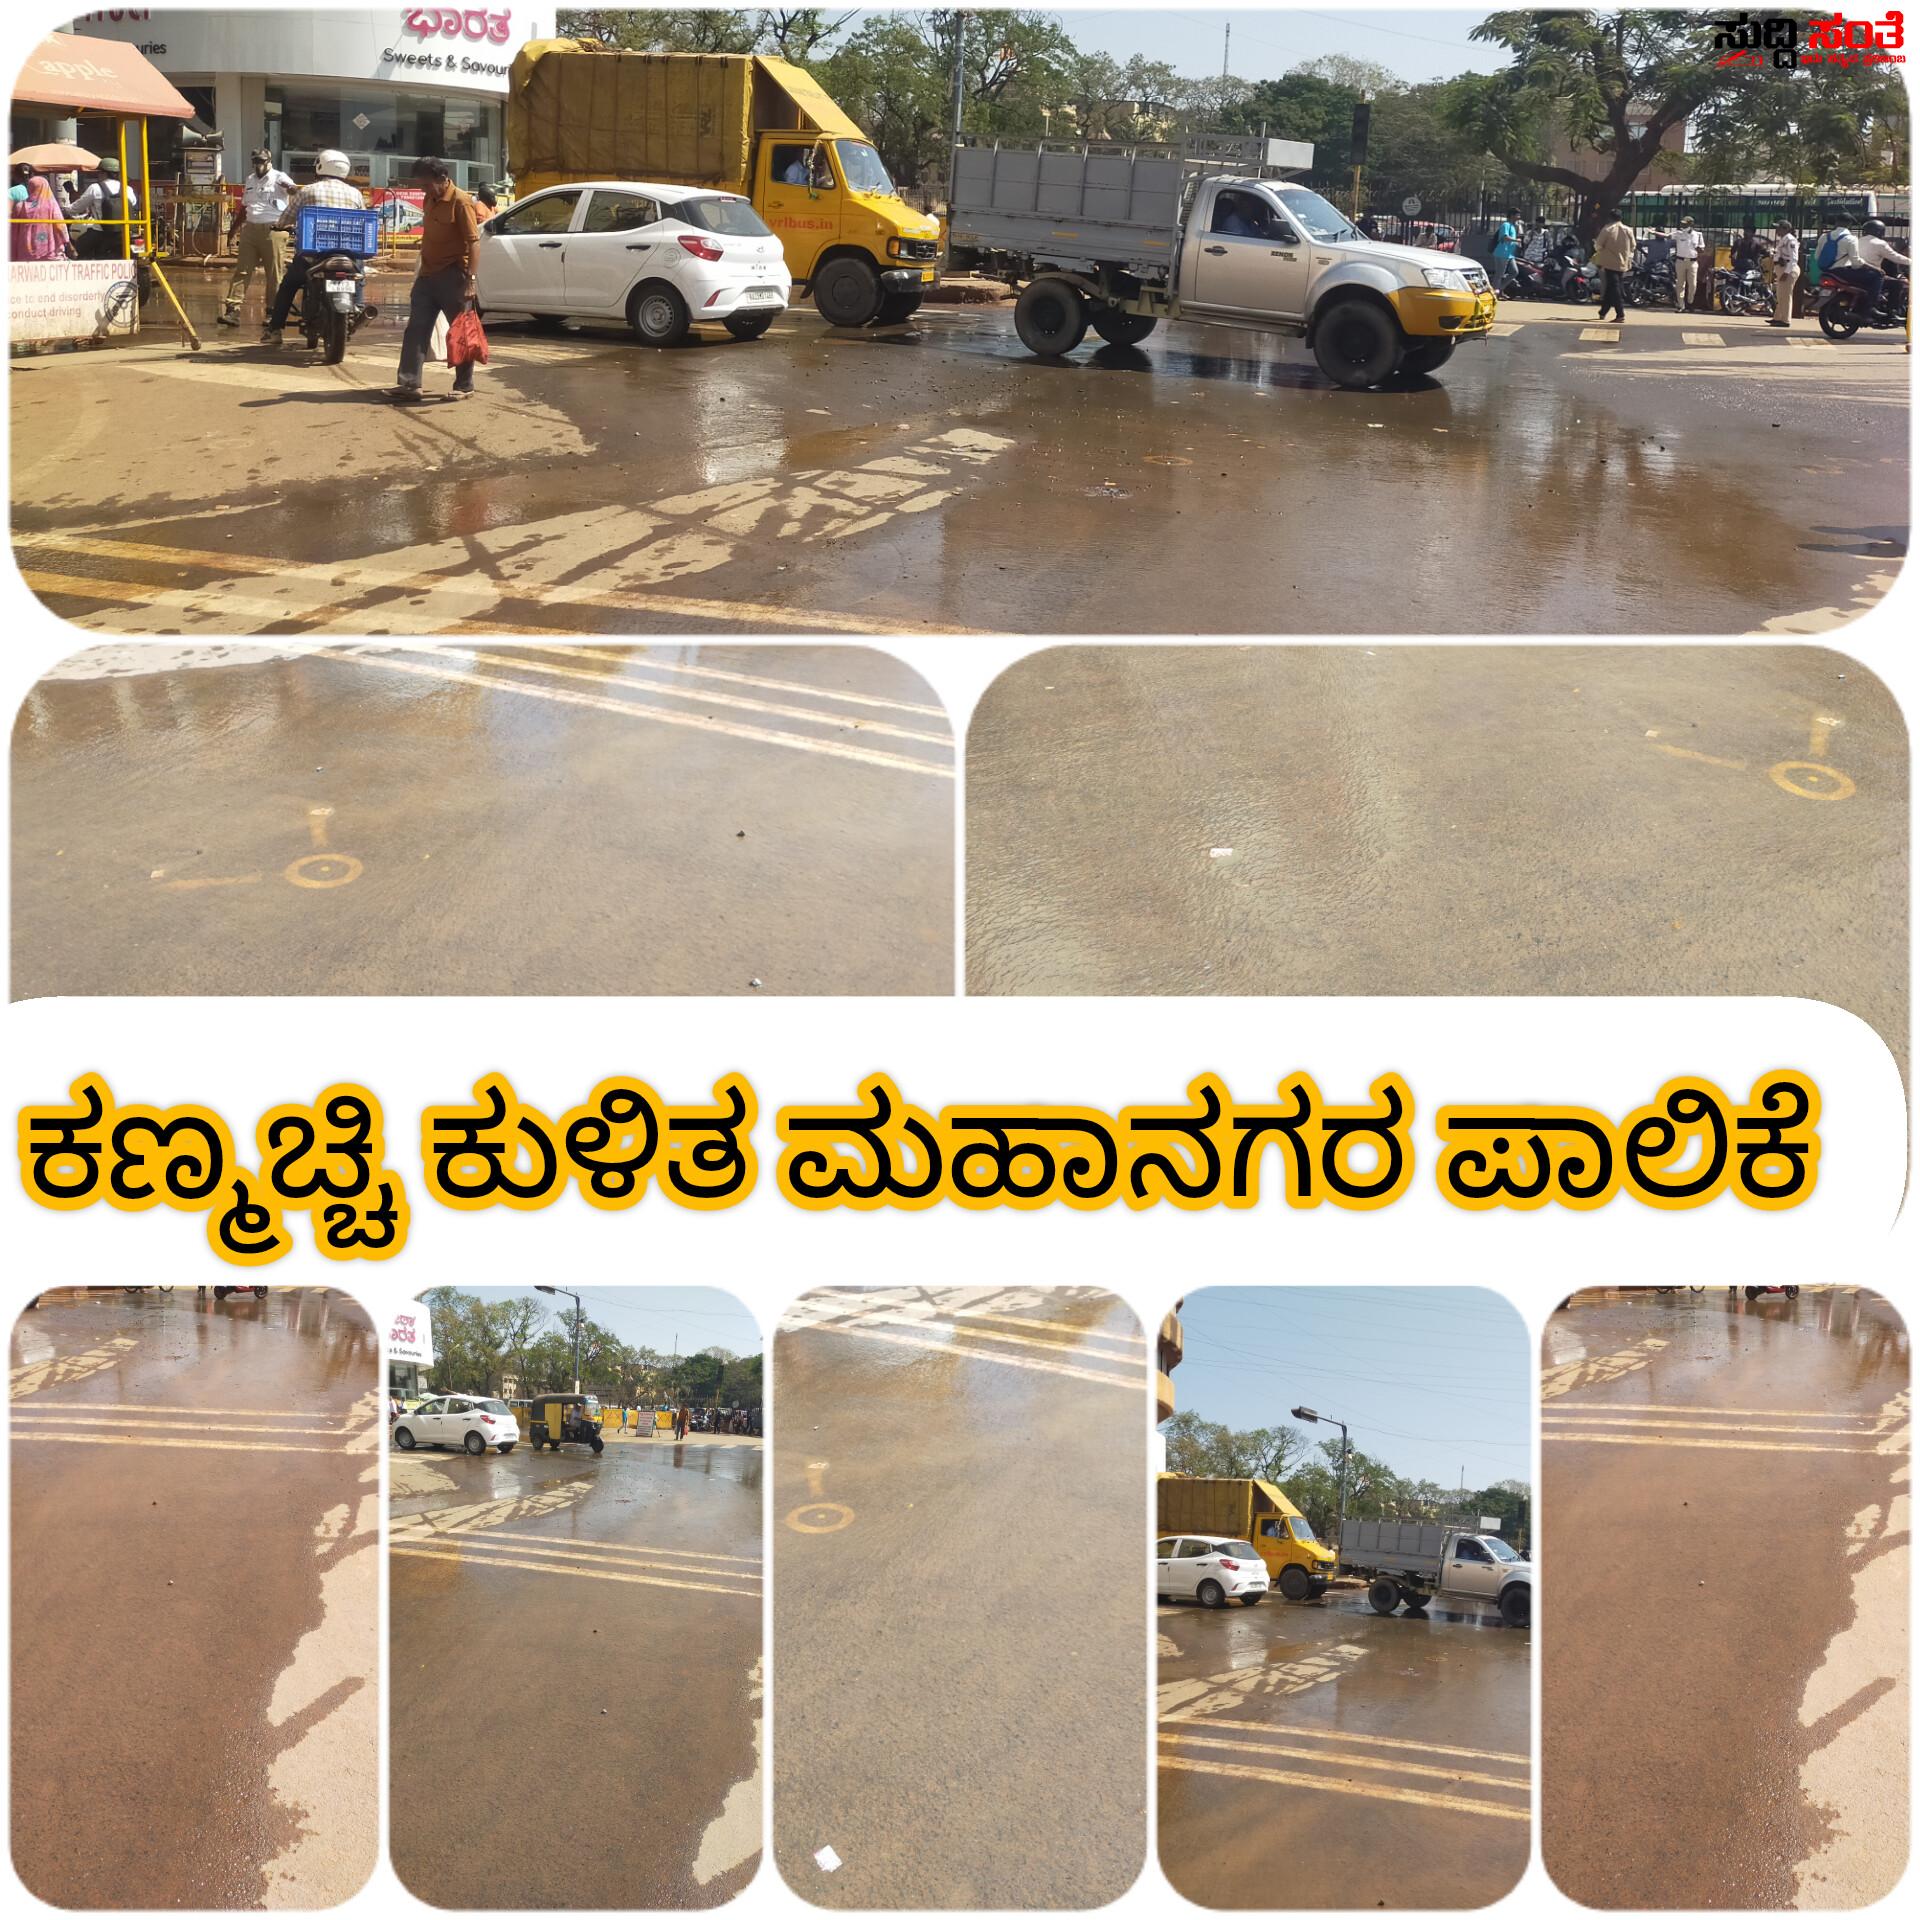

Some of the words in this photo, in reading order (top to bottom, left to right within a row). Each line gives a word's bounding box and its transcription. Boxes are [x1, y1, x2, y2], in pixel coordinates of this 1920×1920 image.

[405, 8, 512, 42] ಭಾರತ
[383, 48, 442, 67] Sweets
[446, 54, 457, 69] &
[768, 215, 833, 231] vrlbus.in
[49, 264, 70, 281] CITY
[71, 263, 109, 280] TRAFFIC
[49, 305, 81, 319] driving
